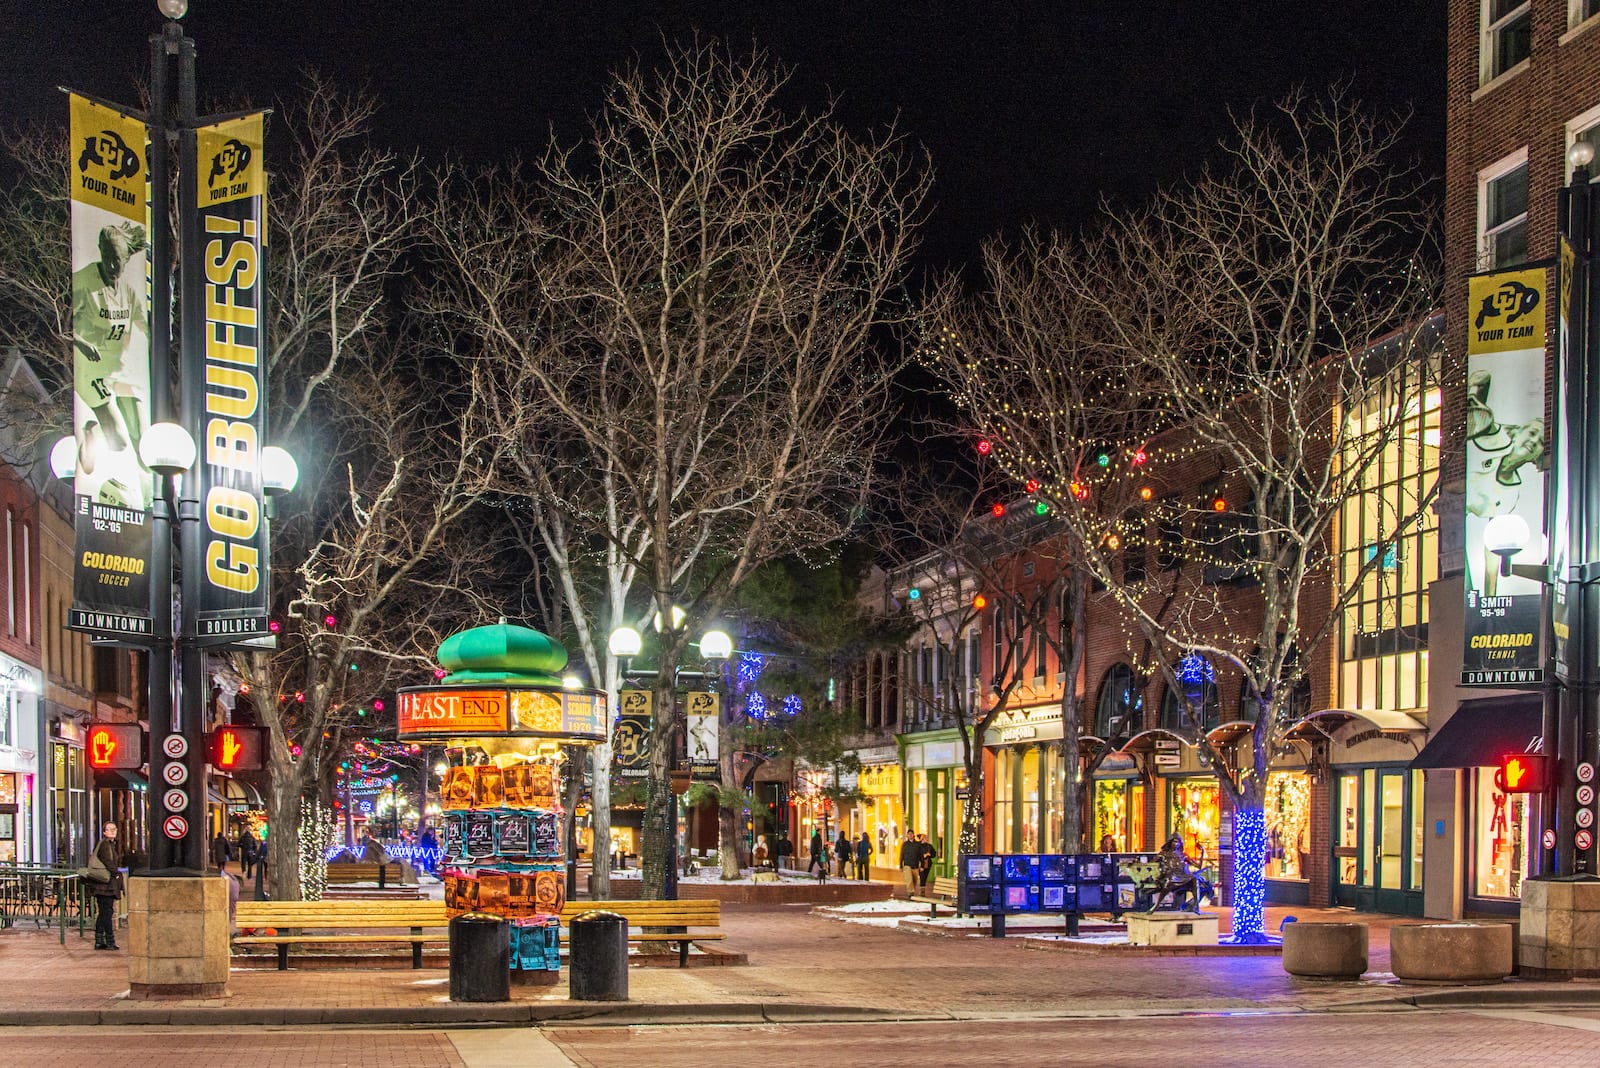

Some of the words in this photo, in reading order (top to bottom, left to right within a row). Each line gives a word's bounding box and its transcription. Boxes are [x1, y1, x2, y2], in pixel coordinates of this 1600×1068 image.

[81, 175, 108, 196] YOUR
[112, 185, 136, 206] TEAM
[210, 186, 228, 201] YOUR
[230, 182, 248, 196] TEAM
[99, 307, 130, 320] COLORADO
[205, 214, 259, 472] BUFFS!
[1477, 328, 1504, 342] YOUR
[1507, 325, 1534, 339] TEAM
[79, 496, 89, 516] fran
[92, 505, 145, 526] MUNNELLY
[205, 486, 260, 595] GO
[82, 551, 145, 575] COLORADO
[99, 573, 130, 587] SOCCER
[1480, 596, 1513, 608] SMITH
[79, 612, 146, 633] DOWNTOWN
[207, 618, 257, 634] BOULDER
[1470, 633, 1534, 649] COLORADO
[1487, 650, 1517, 660] TENNIS
[1468, 670, 1536, 684] DOWNTOWN
[411, 695, 460, 720] EAST
[462, 700, 500, 715] END
